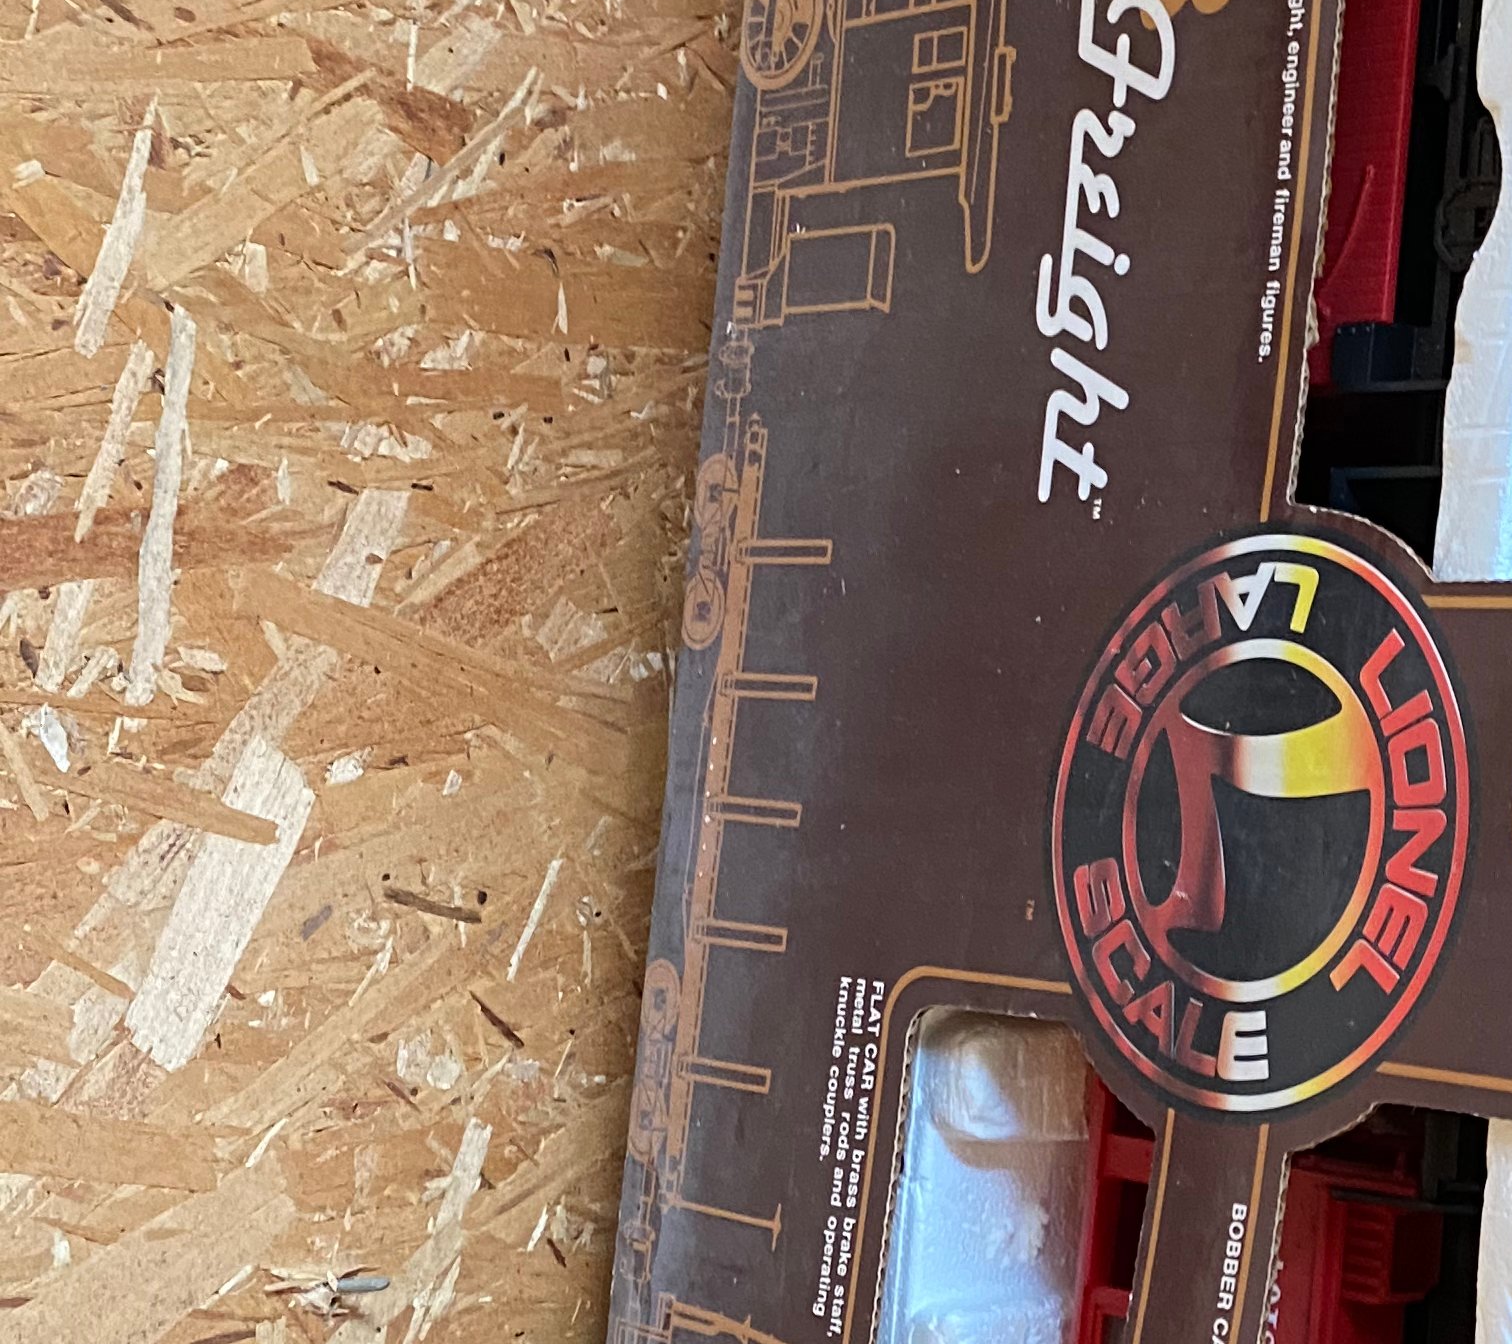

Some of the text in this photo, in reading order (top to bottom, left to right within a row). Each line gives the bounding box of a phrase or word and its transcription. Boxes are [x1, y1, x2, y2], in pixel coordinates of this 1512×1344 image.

[1277, 140, 1291, 180] and
[1282, 41, 1299, 136] engineer
[1258, 281, 1280, 362] figures.
[1268, 189, 1289, 271] fireman
[1086, 561, 1321, 758] LARGE
[1330, 627, 1448, 996] LIONEL
[1073, 856, 1270, 1082] SCALE
[813, 979, 866, 1316] metal truss rods and operating
[819, 977, 852, 1161] knuckle couplers.
[827, 981, 884, 1337] FLAT CAR with brass brake staff,
[1217, 1204, 1247, 1309] BOBBER
